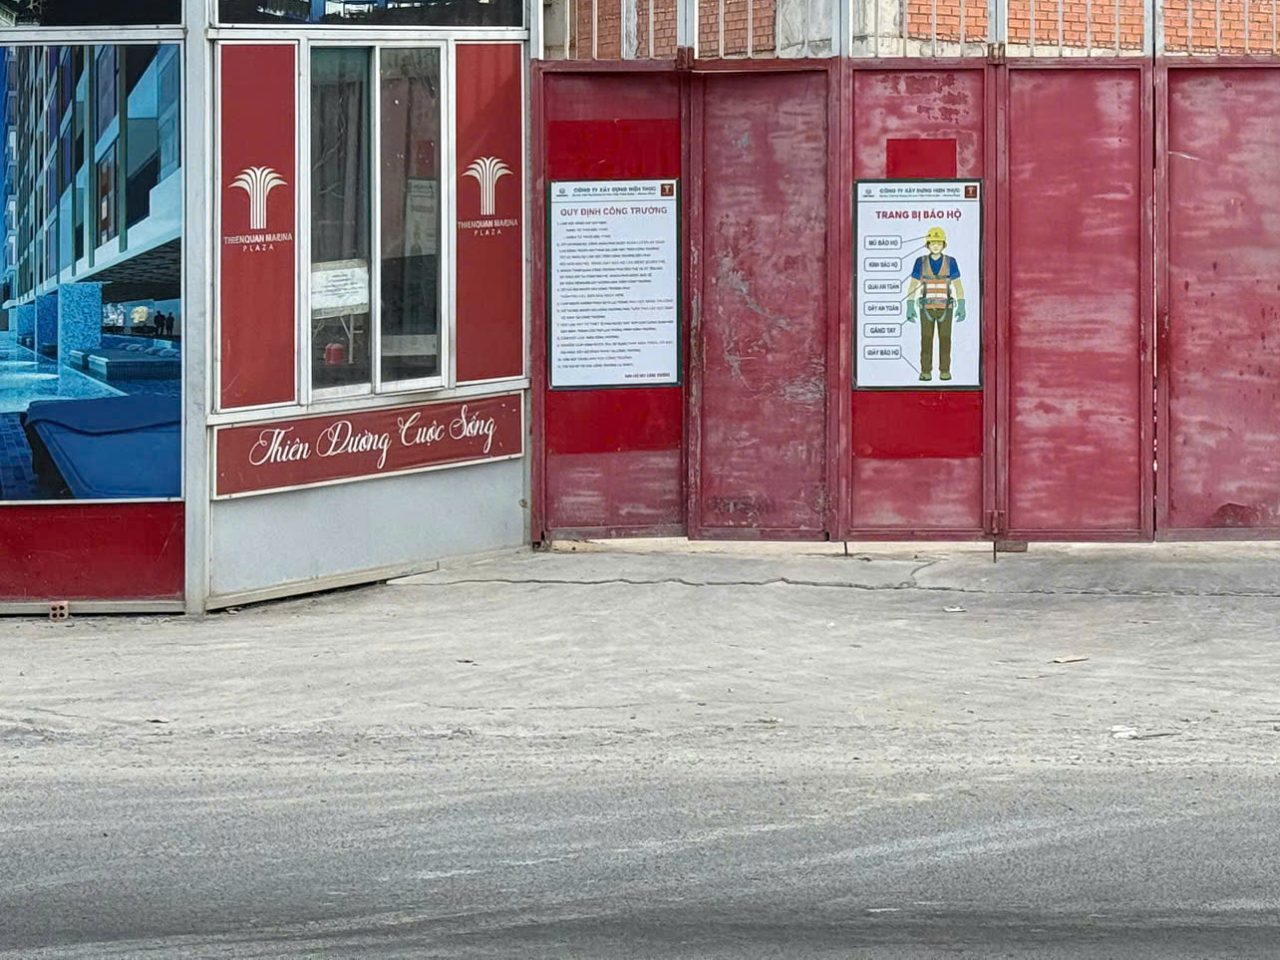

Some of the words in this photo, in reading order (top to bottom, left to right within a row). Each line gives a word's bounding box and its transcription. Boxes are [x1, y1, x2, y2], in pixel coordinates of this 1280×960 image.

[560, 208, 578, 216] QUY
[580, 206, 600, 217] ĐỊNH
[603, 206, 628, 216] CÔNG
[631, 206, 668, 216] TRƯỜNG
[876, 210, 909, 219] TRANG
[912, 210, 920, 221] BỊ
[924, 208, 944, 218] BẢO
[947, 208, 962, 221] HỘ
[474, 228, 502, 236] PLAZA
[224, 234, 264, 244] THIENQUAN
[242, 244, 274, 252] PLAZA
[249, 426, 311, 466] Thiên
[398, 412, 445, 447] Cuộc
[450, 404, 498, 454] Sống
